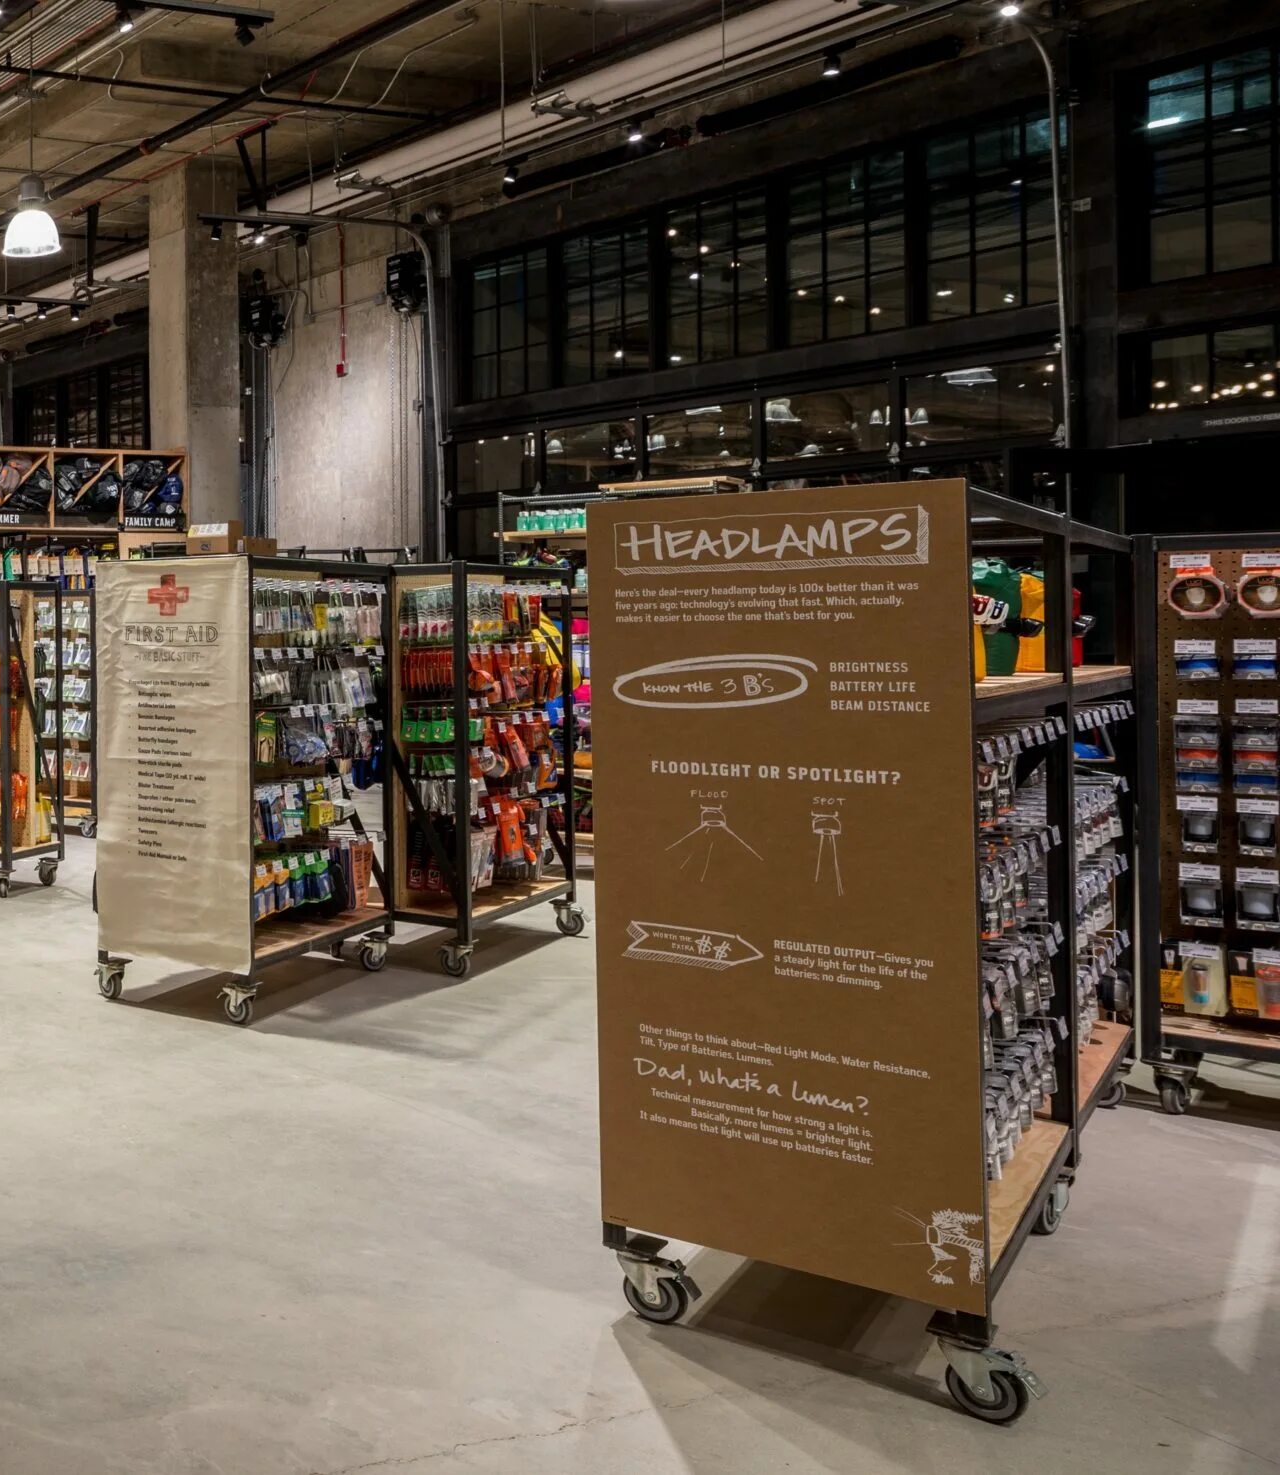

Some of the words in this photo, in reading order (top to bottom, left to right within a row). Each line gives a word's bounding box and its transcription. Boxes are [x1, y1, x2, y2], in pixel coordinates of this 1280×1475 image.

[126, 516, 152, 527] FAMILY
[155, 518, 176, 527] CAMP
[621, 513, 911, 560] HEADLAMPS
[615, 588, 640, 598] Here's
[642, 588, 656, 597] the
[712, 585, 757, 597] headlamp
[760, 584, 786, 595] today
[789, 584, 797, 593] is
[800, 583, 824, 593] 100x
[827, 583, 857, 593] better
[860, 582, 884, 592] than
[887, 581, 894, 591] it
[898, 582, 919, 591] was
[616, 601, 631, 610] five
[633, 602, 658, 612] years
[680, 599, 735, 611] technology's
[738, 598, 776, 609] evolving
[779, 597, 799, 607] that
[802, 597, 823, 607] fast.
[616, 614, 643, 623] makes
[646, 613, 652, 622] it
[654, 613, 681, 622] easier
[683, 614, 692, 622] to
[694, 613, 725, 622] choose
[727, 612, 743, 621] the
[746, 613, 762, 621] one
[764, 611, 791, 621] that's
[794, 611, 815, 620] best
[817, 610, 831, 620] for
[834, 611, 855, 622] you.
[125, 625, 179, 643] FIRST
[186, 625, 219, 643] AID
[153, 651, 176, 662] BASIC
[830, 662, 909, 673] BRIGHTNESS
[642, 682, 680, 694] KNOW
[684, 681, 714, 693] THE
[721, 679, 737, 694] 3
[830, 681, 884, 692] BATTERY
[889, 682, 917, 693] LIFE
[831, 700, 864, 711] BEAM
[868, 701, 931, 713] DISTANCE
[651, 760, 752, 778] FLOODLIGHT
[758, 765, 781, 780] OR
[787, 766, 901, 785] SPOTLIGHT?
[690, 789, 729, 800] FLOOD
[812, 797, 847, 806] SPOT
[652, 931, 678, 941] WORTH
[672, 942, 695, 952] EXTRA
[774, 940, 831, 955] REGULATED
[914, 957, 934, 968] you
[783, 955, 815, 969] steady
[818, 958, 840, 971] light
[843, 961, 857, 972] for
[859, 964, 876, 974] the
[879, 965, 895, 977] life
[897, 968, 908, 978] of
[911, 970, 928, 981] the
[822, 974, 834, 982] no
[836, 974, 883, 991] dimming.
[640, 1024, 663, 1035] Other
[666, 1027, 693, 1041] things
[695, 1032, 704, 1042] to
[706, 1034, 729, 1046] think
[784, 1046, 809, 1060] Light
[842, 1056, 871, 1069] Water
[658, 1039, 679, 1051] Type
[680, 1043, 690, 1052] of
[736, 1052, 774, 1067] Lumens.
[633, 1058, 692, 1087] Dad,
[699, 1067, 762, 1092] what's
[767, 1083, 783, 1097] a
[792, 1080, 869, 1116] lumen?
[651, 1088, 691, 1103] Technical
[693, 1097, 754, 1115] measurement
[756, 1108, 770, 1117] for
[772, 1110, 792, 1122] how
[795, 1117, 826, 1131] strong
[837, 1122, 860, 1136] light
[862, 1128, 873, 1138] is.
[640, 1110, 648, 1120] It
[650, 1113, 667, 1124] also
[669, 1118, 698, 1130] means
[700, 1123, 719, 1134] that
[721, 1127, 741, 1139] light
[744, 1132, 760, 1142] will
[762, 1137, 779, 1146] use
[781, 1140, 793, 1150] up
[796, 1141, 840, 1158] batteries
[842, 1150, 874, 1166] faster.
[735, 1118, 758, 1129] more
[760, 1121, 794, 1136] lumens
[806, 1130, 845, 1144] brighter
[848, 1138, 874, 1152] light.
